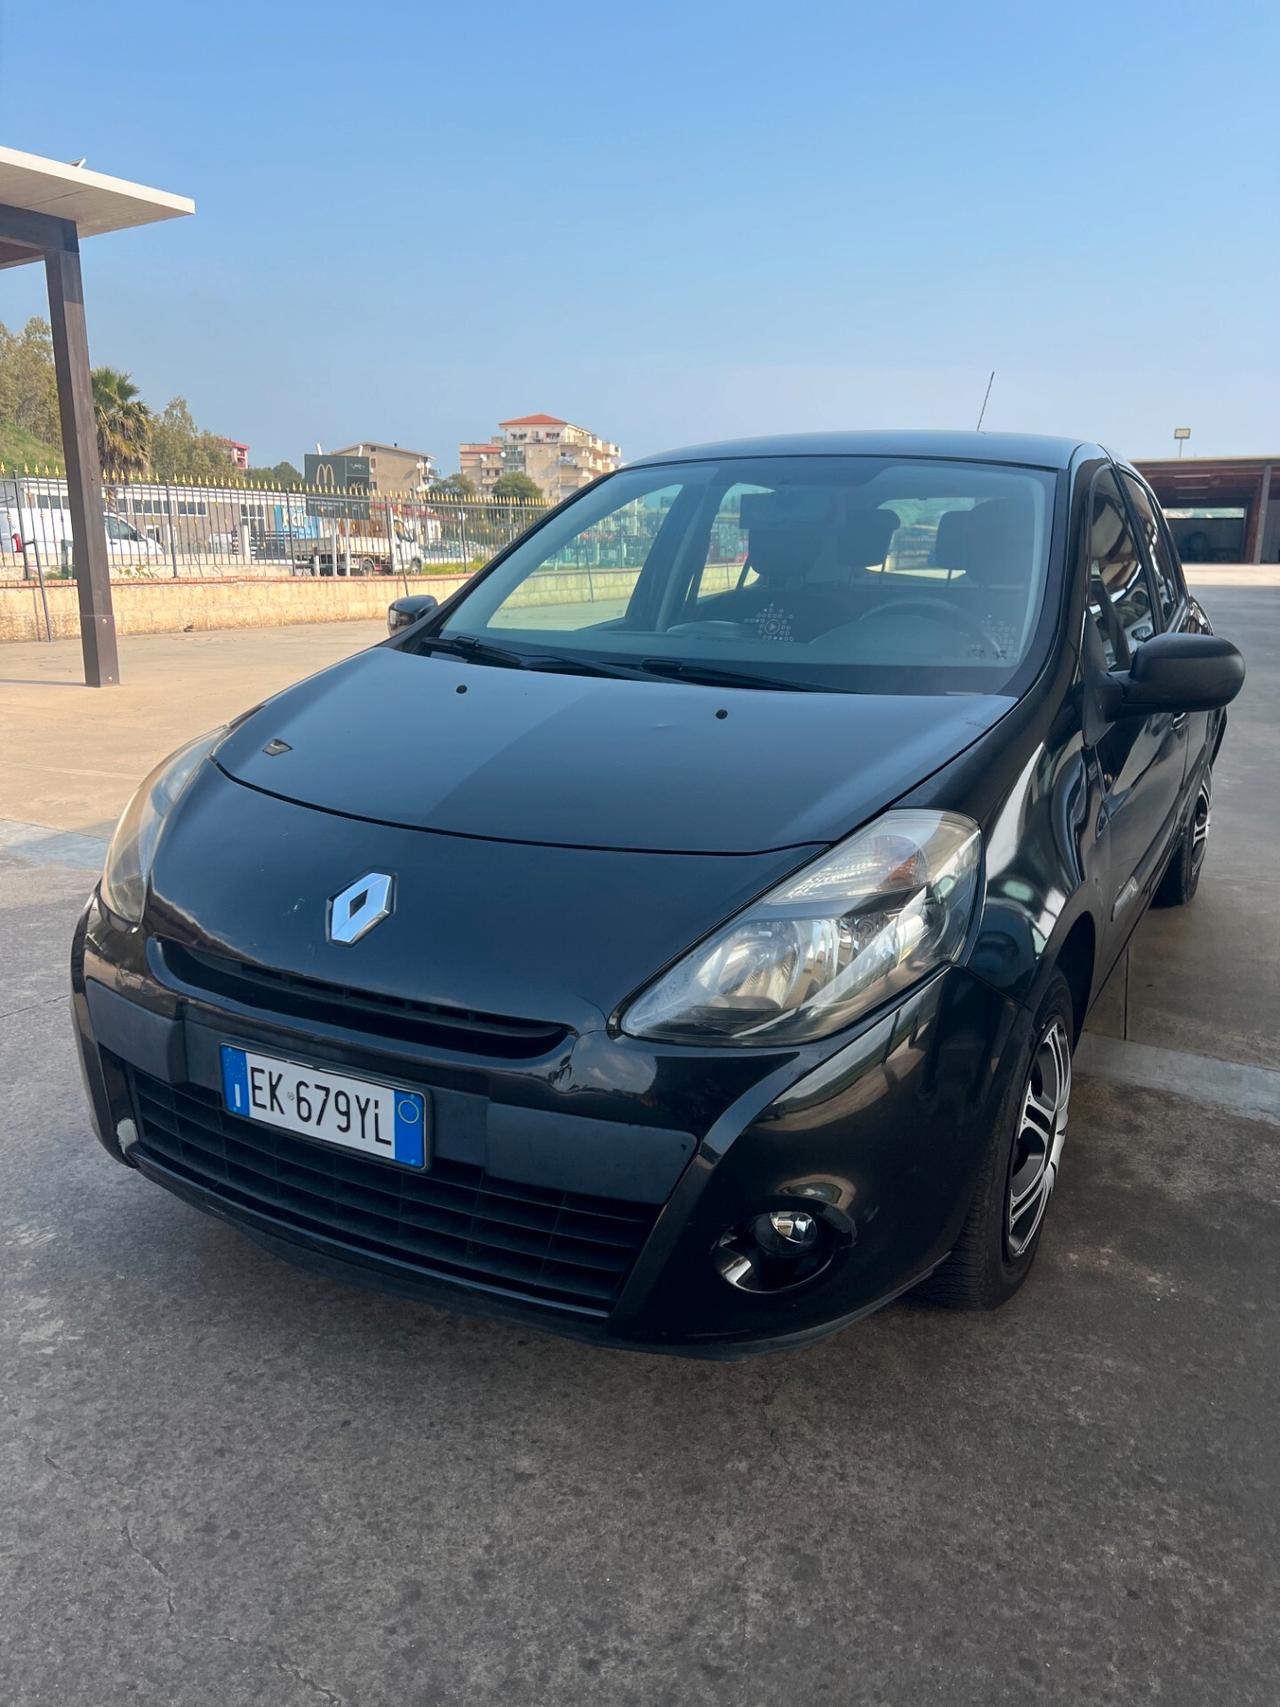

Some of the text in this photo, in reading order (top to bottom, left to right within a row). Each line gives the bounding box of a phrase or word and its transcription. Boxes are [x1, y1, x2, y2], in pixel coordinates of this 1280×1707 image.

[234, 1083, 241, 1107] I
[250, 1066, 392, 1146] EK 679YL
